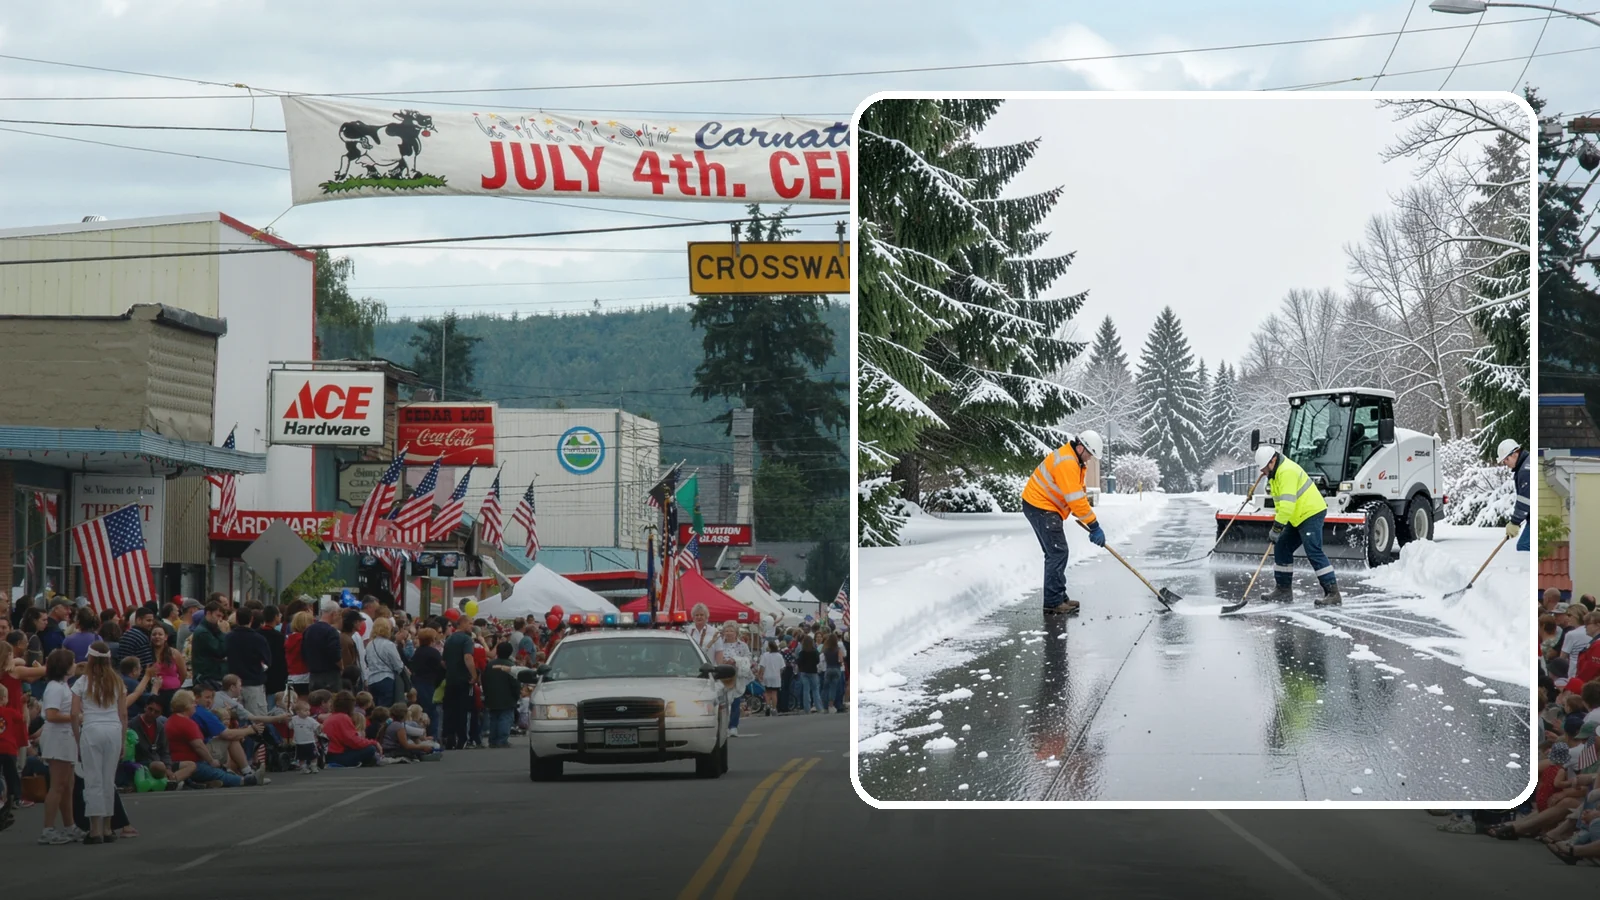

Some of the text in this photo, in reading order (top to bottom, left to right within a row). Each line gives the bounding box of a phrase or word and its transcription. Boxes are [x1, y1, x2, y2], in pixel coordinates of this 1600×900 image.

[695, 121, 850, 150] Carnat
[481, 140, 605, 193] JULY
[632, 149, 746, 199] 4th.
[697, 254, 850, 280] CROSSWA
[283, 380, 373, 420] ACE
[406, 409, 452, 422] CEDAR
[283, 421, 371, 437] Hardware
[83, 485, 155, 495] St. Vincent de Paul
[699, 535, 730, 543] GLASS
